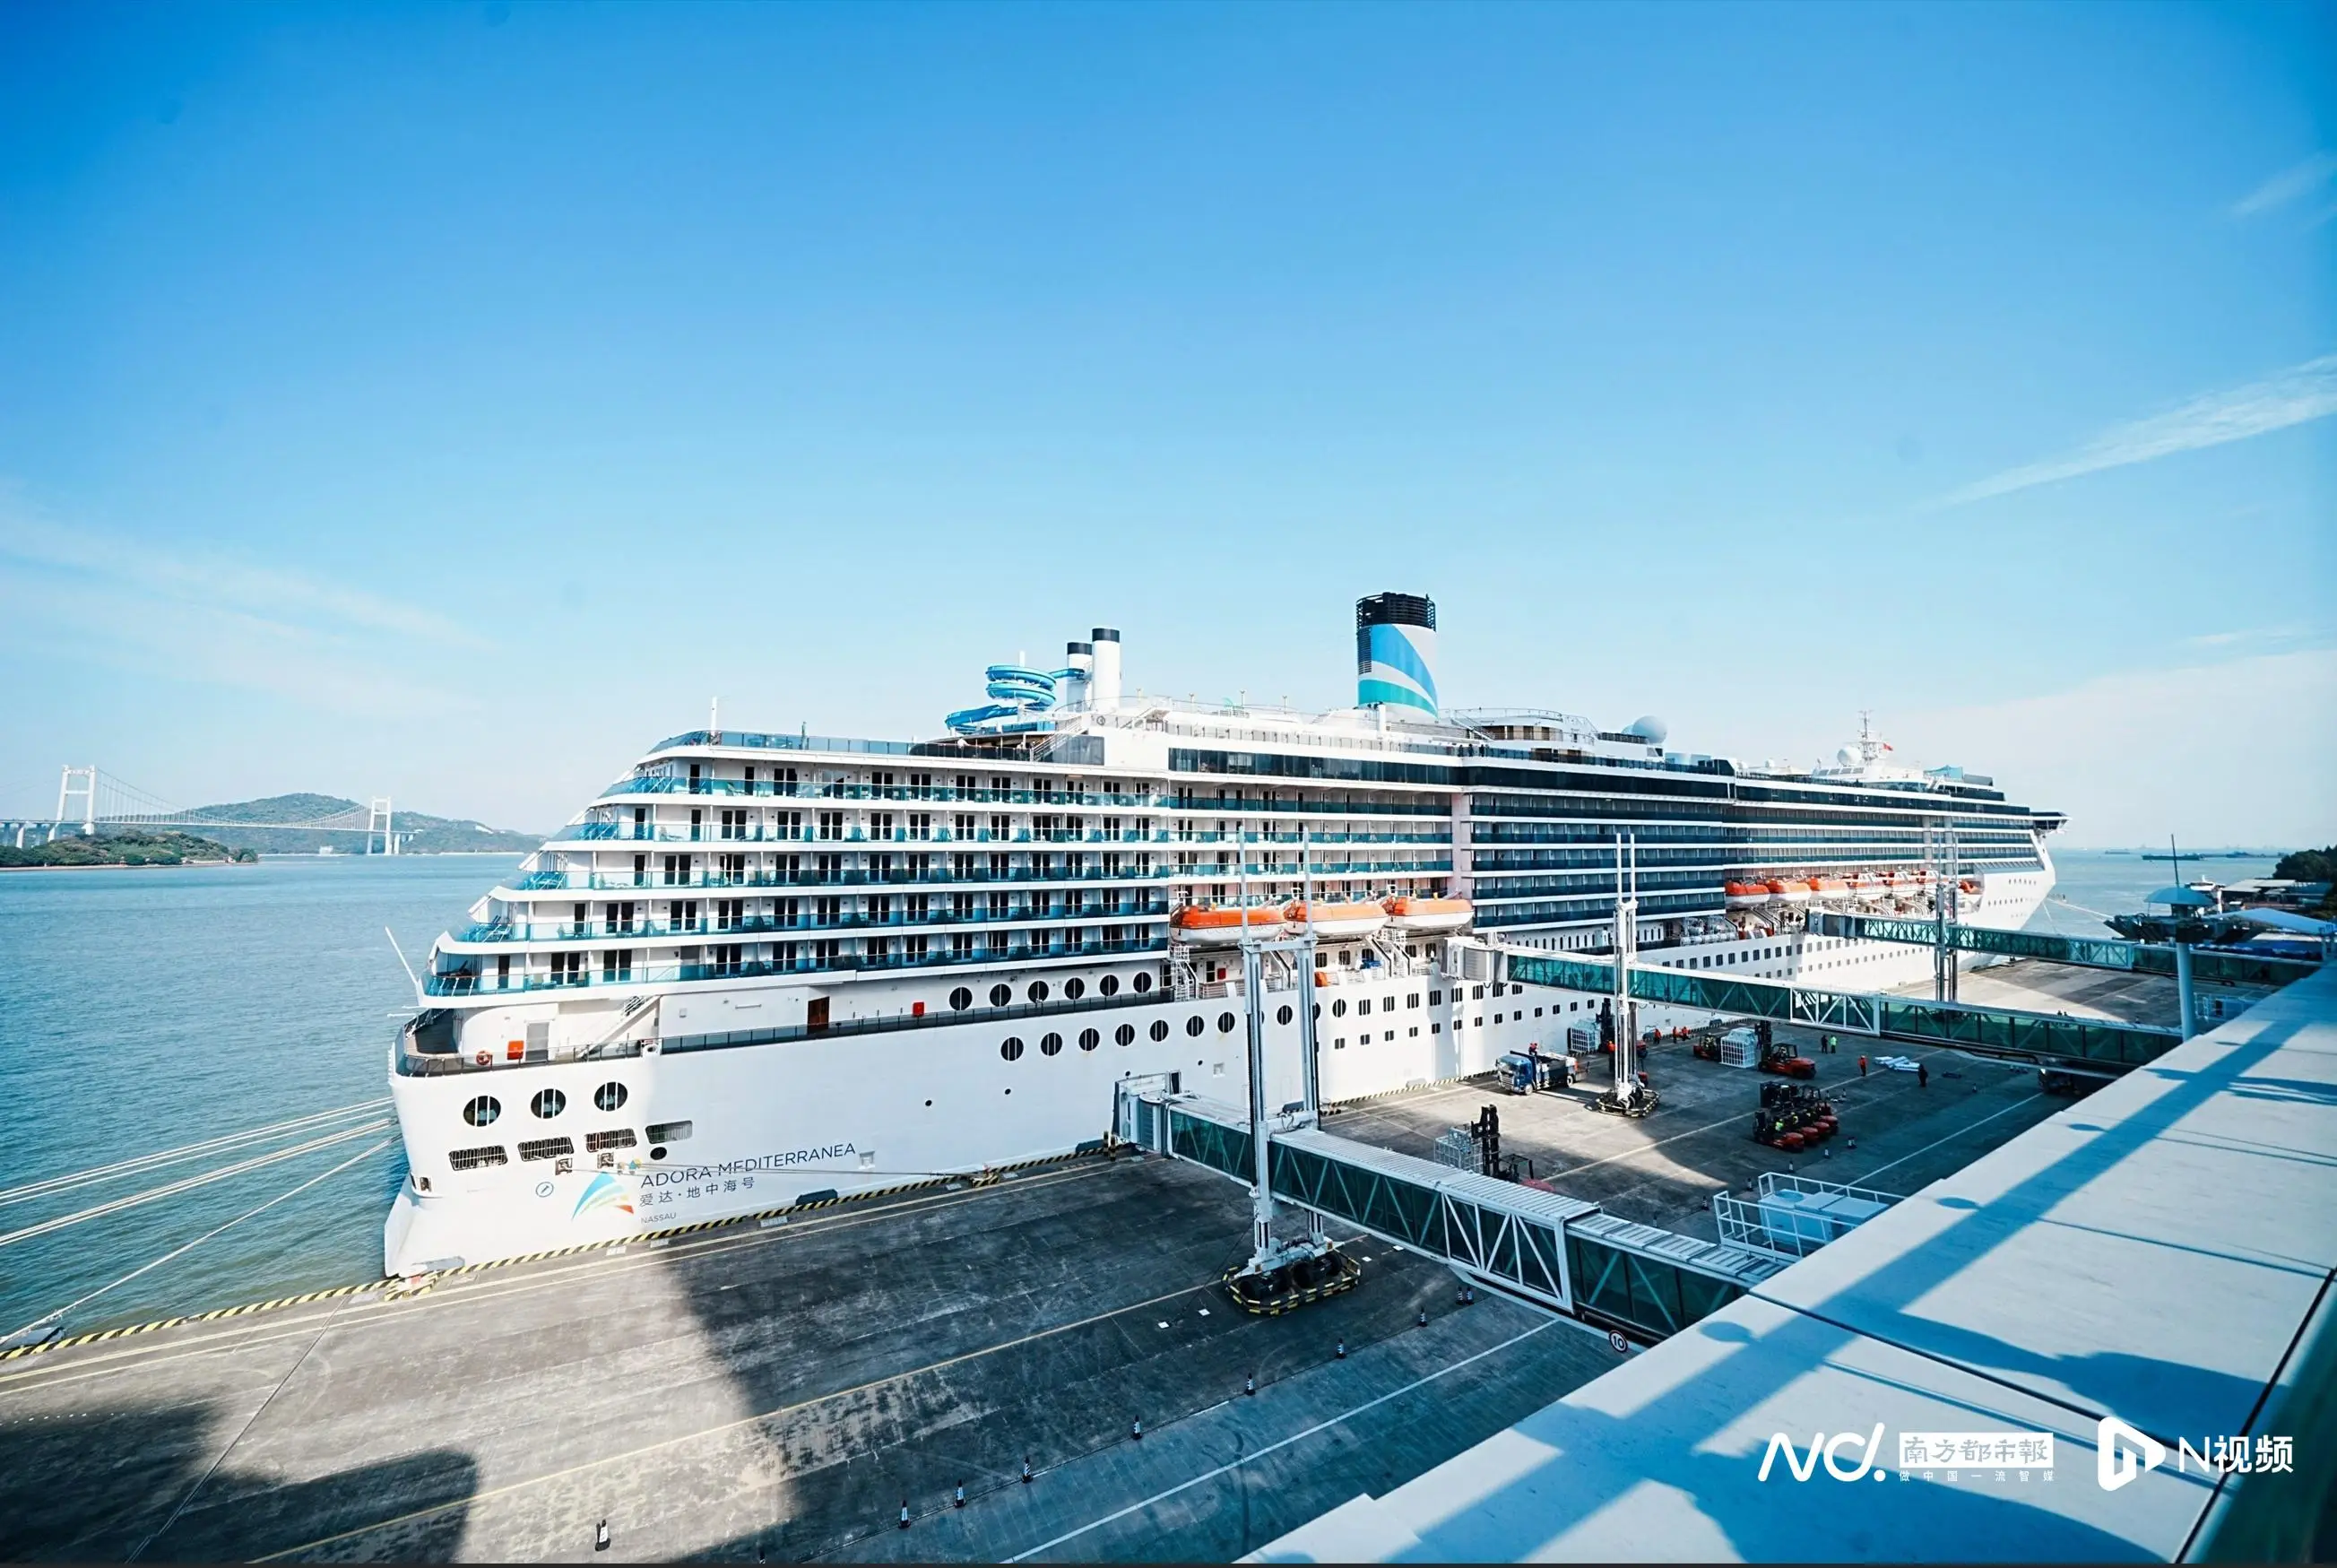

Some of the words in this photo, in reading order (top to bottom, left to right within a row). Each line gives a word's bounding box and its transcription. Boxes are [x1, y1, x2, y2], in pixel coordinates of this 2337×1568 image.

[640, 1166, 712, 1189] ADORA
[718, 1143, 856, 1177] MEDITERRANEA
[639, 1176, 756, 1208] 爱达·地中海号
[640, 1211, 677, 1225] NASSAU
